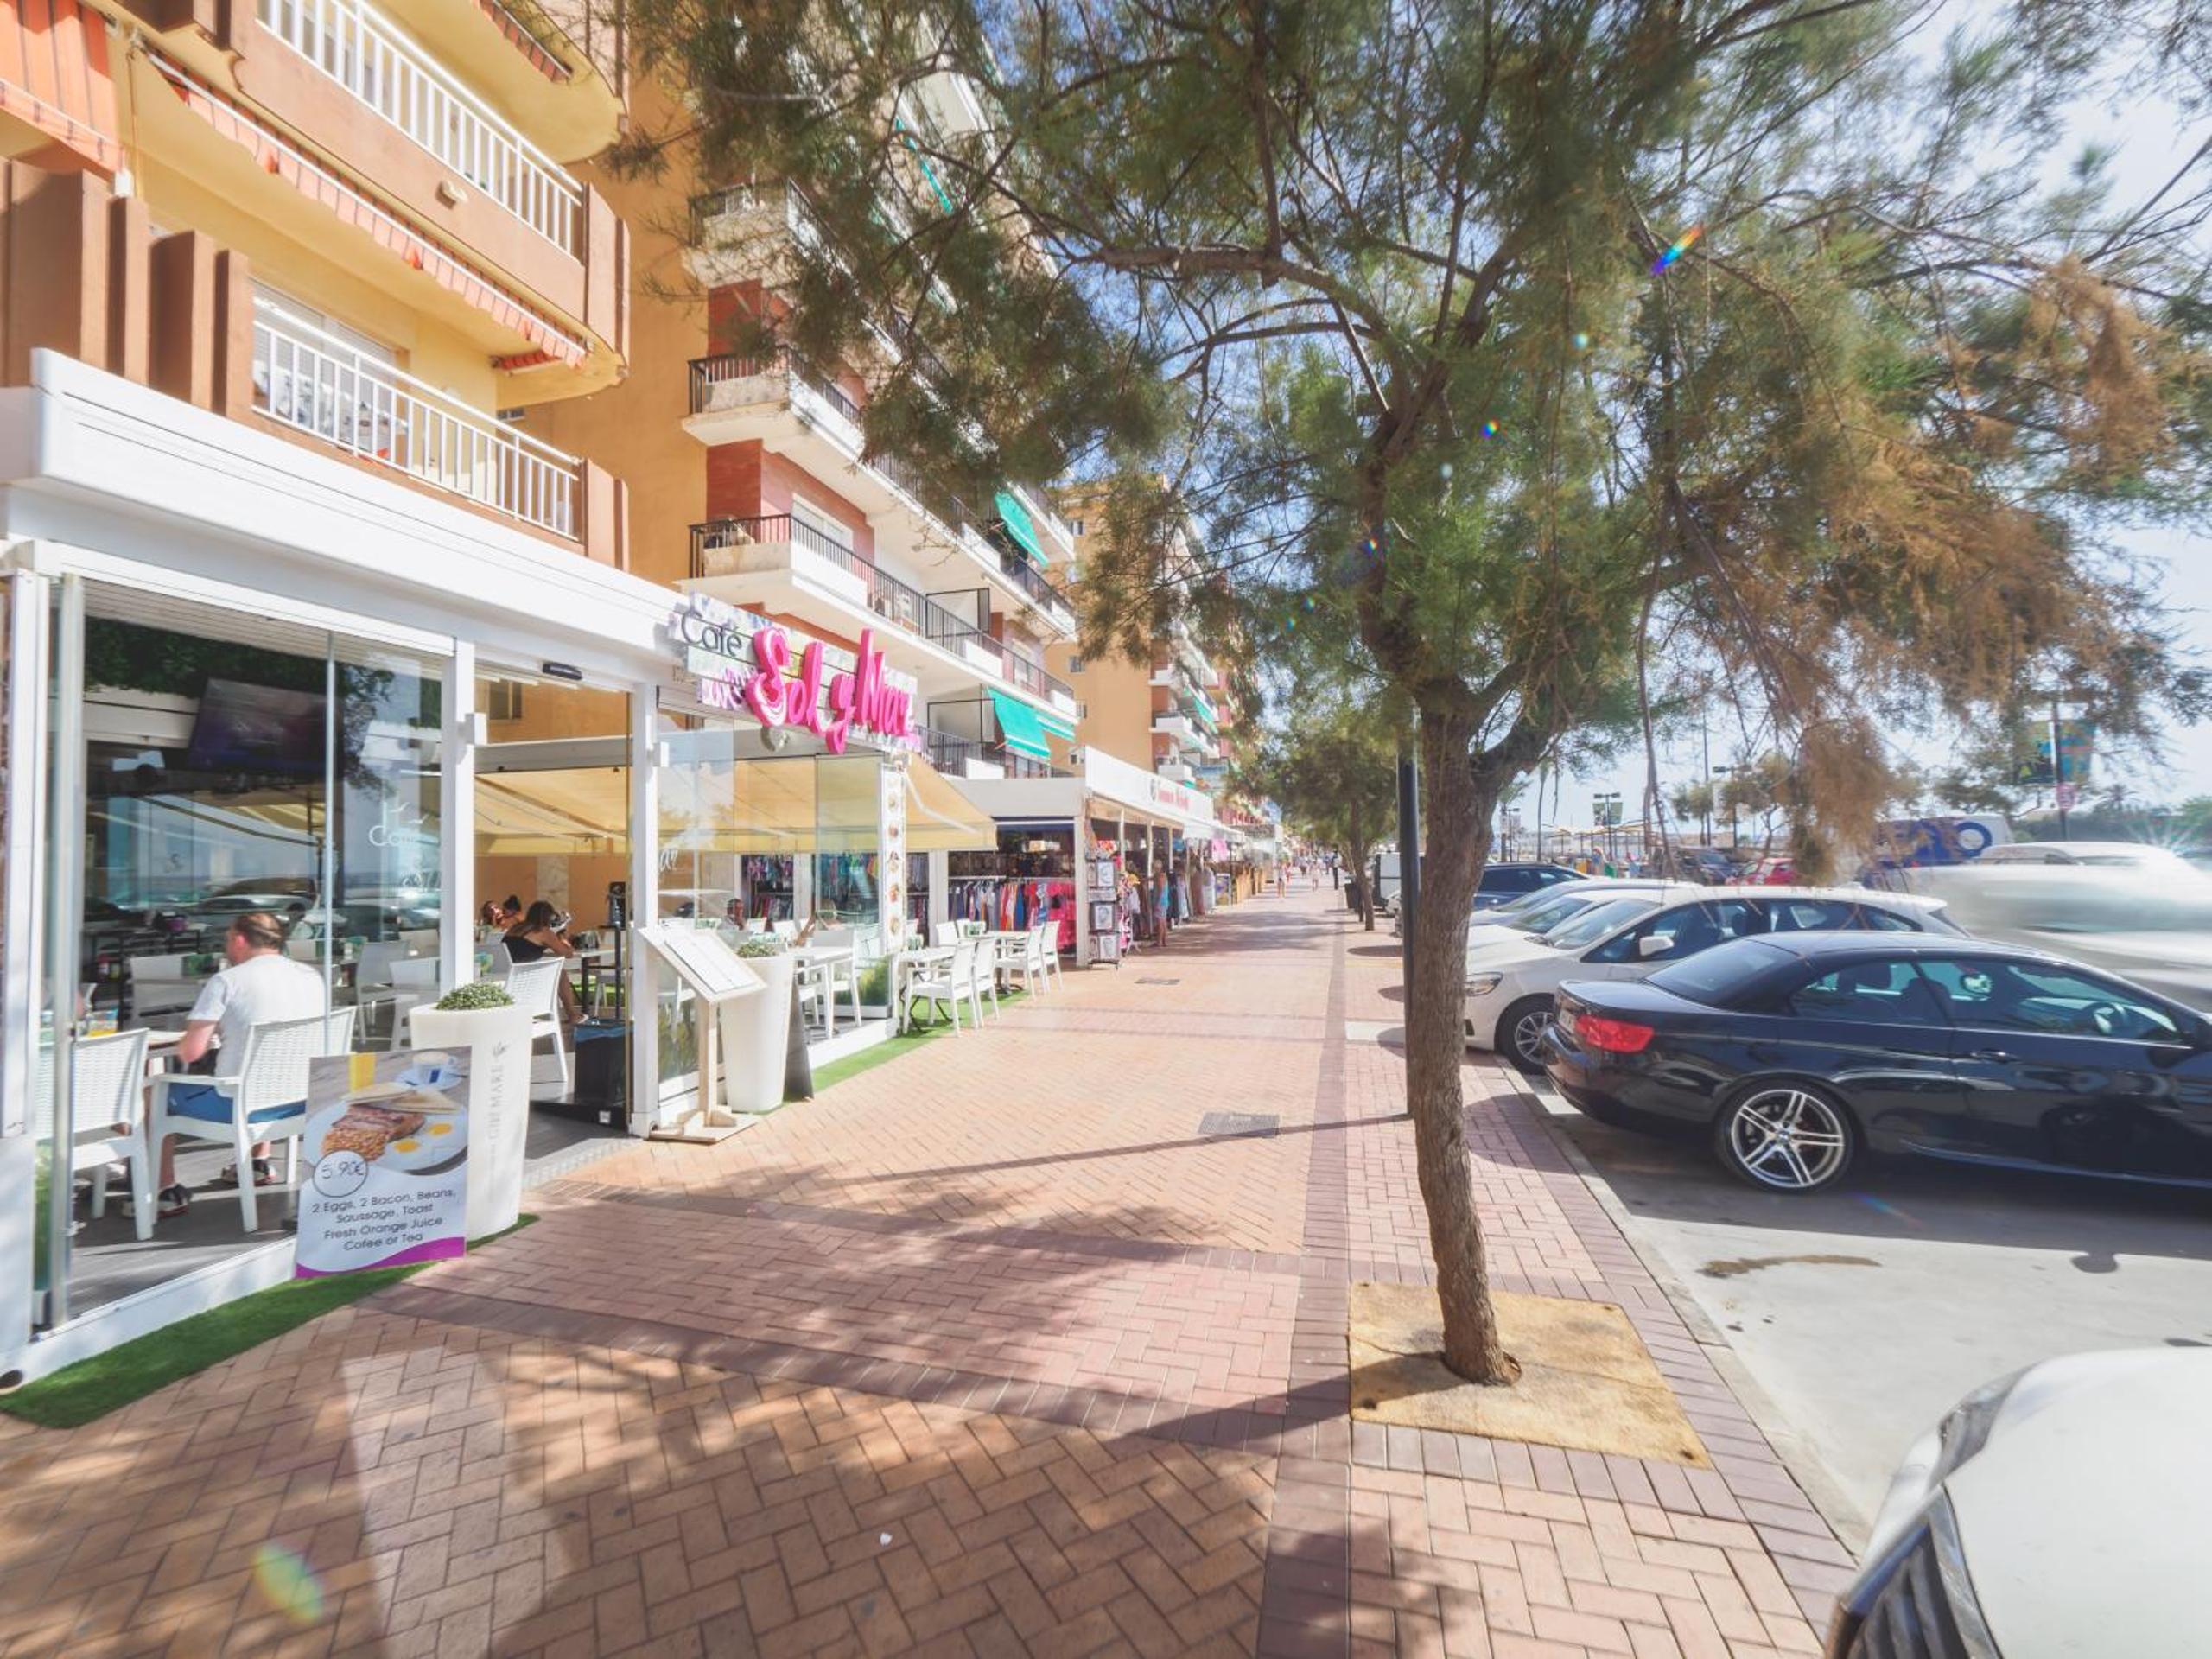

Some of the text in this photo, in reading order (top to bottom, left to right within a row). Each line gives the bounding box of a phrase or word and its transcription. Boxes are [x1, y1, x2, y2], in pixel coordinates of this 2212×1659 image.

[681, 608, 743, 658] Café
[746, 626, 827, 734] Sol
[827, 673, 856, 754] y
[312, 1203, 321, 1214] 2
[359, 1197, 368, 1207] 2
[402, 1204, 433, 1215] Toast
[324, 1217, 442, 1239] Fresh Orange Juice
[385, 1236, 398, 1245] or
[402, 1233, 423, 1243] Tea
